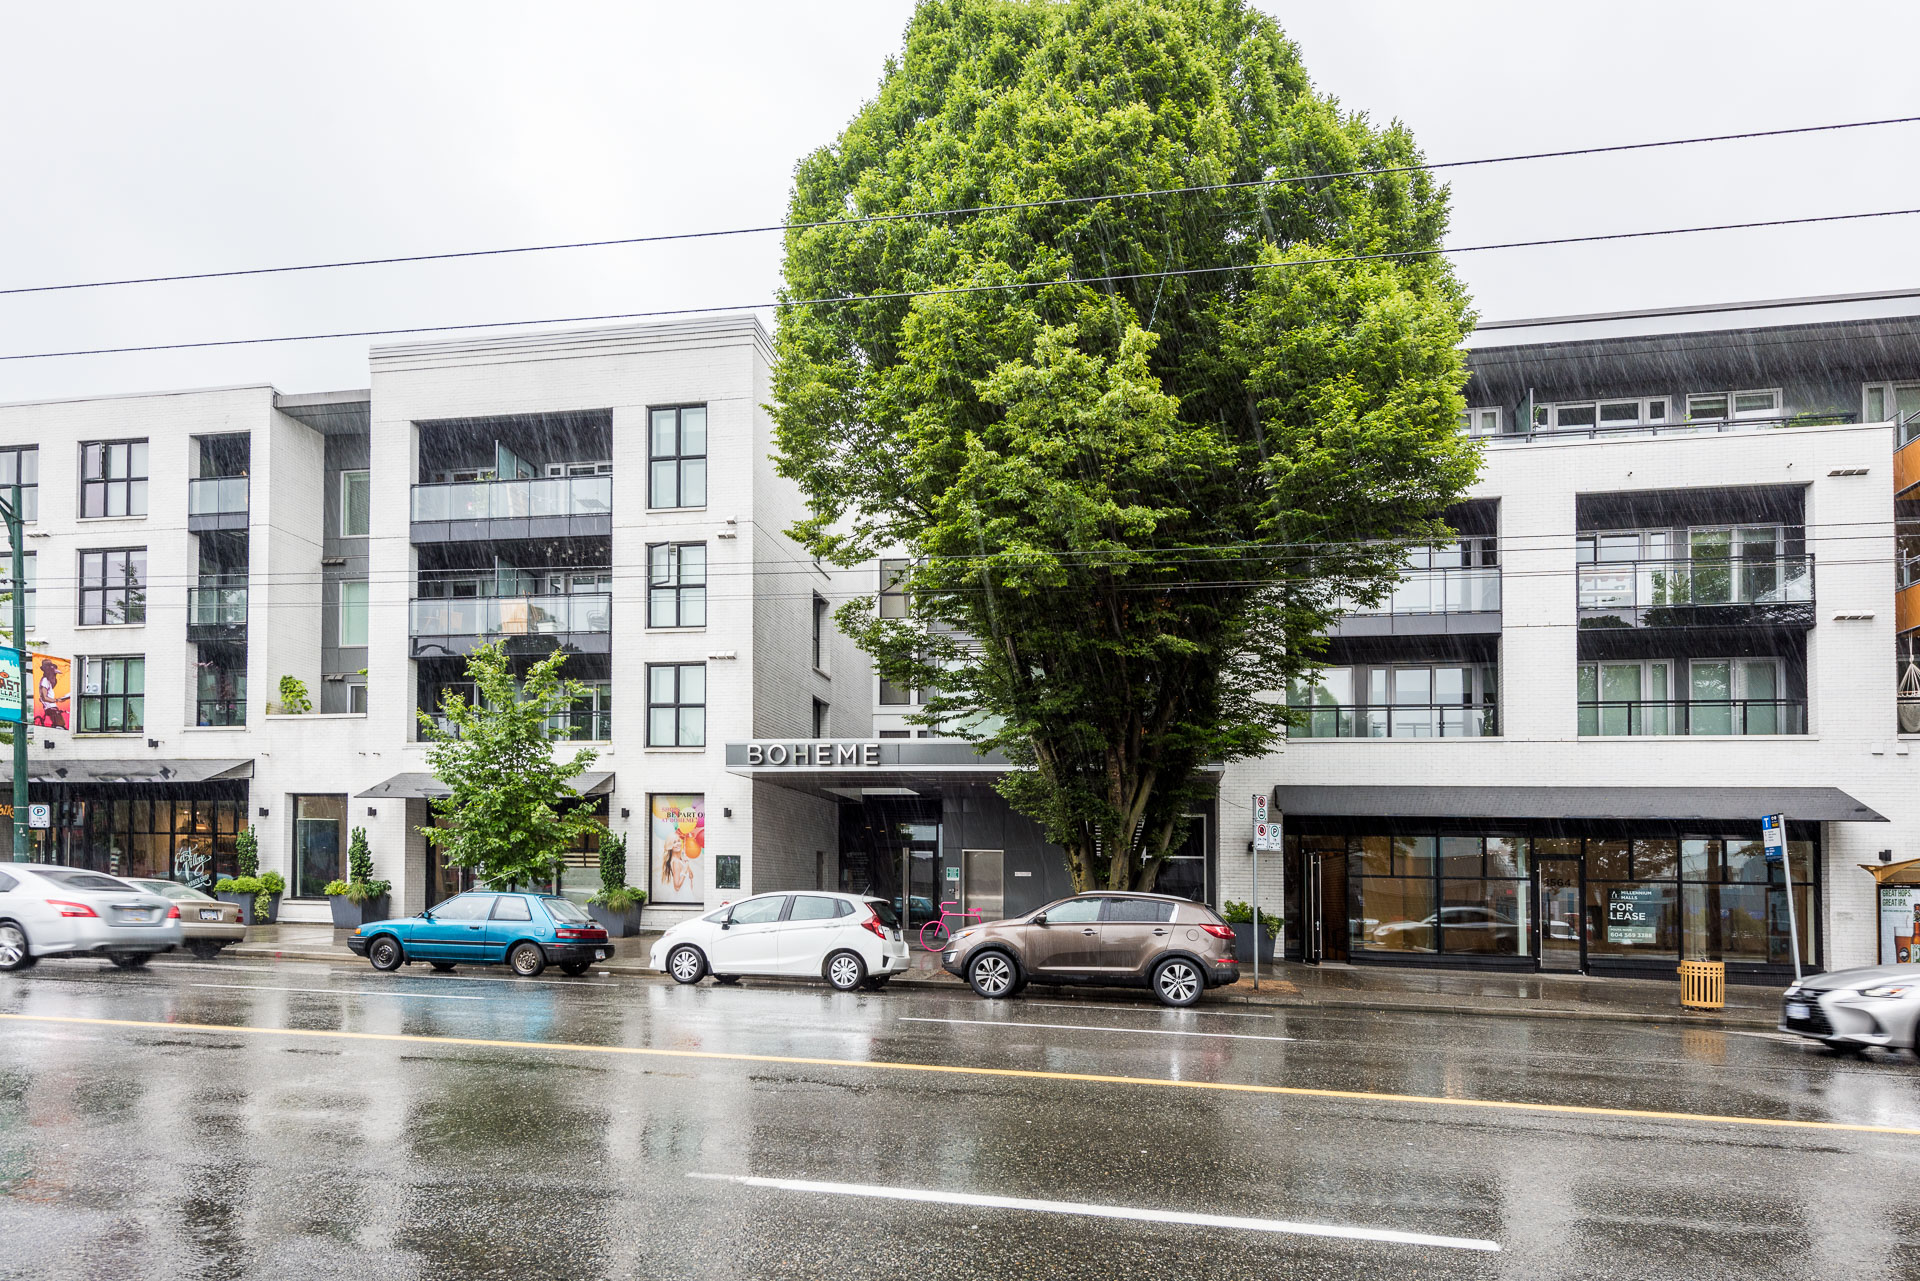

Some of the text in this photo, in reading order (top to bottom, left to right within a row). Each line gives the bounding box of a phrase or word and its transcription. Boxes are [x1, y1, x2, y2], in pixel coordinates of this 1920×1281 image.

[0, 678, 20, 693] AST
[0, 689, 20, 699] LLAGE
[747, 744, 880, 766] BOHEME
[1882, 889, 1897, 898] GREAT
[1610, 903, 1634, 911] FOR
[1882, 898, 1898, 907] GREAT
[1610, 912, 1646, 920] LEASE
